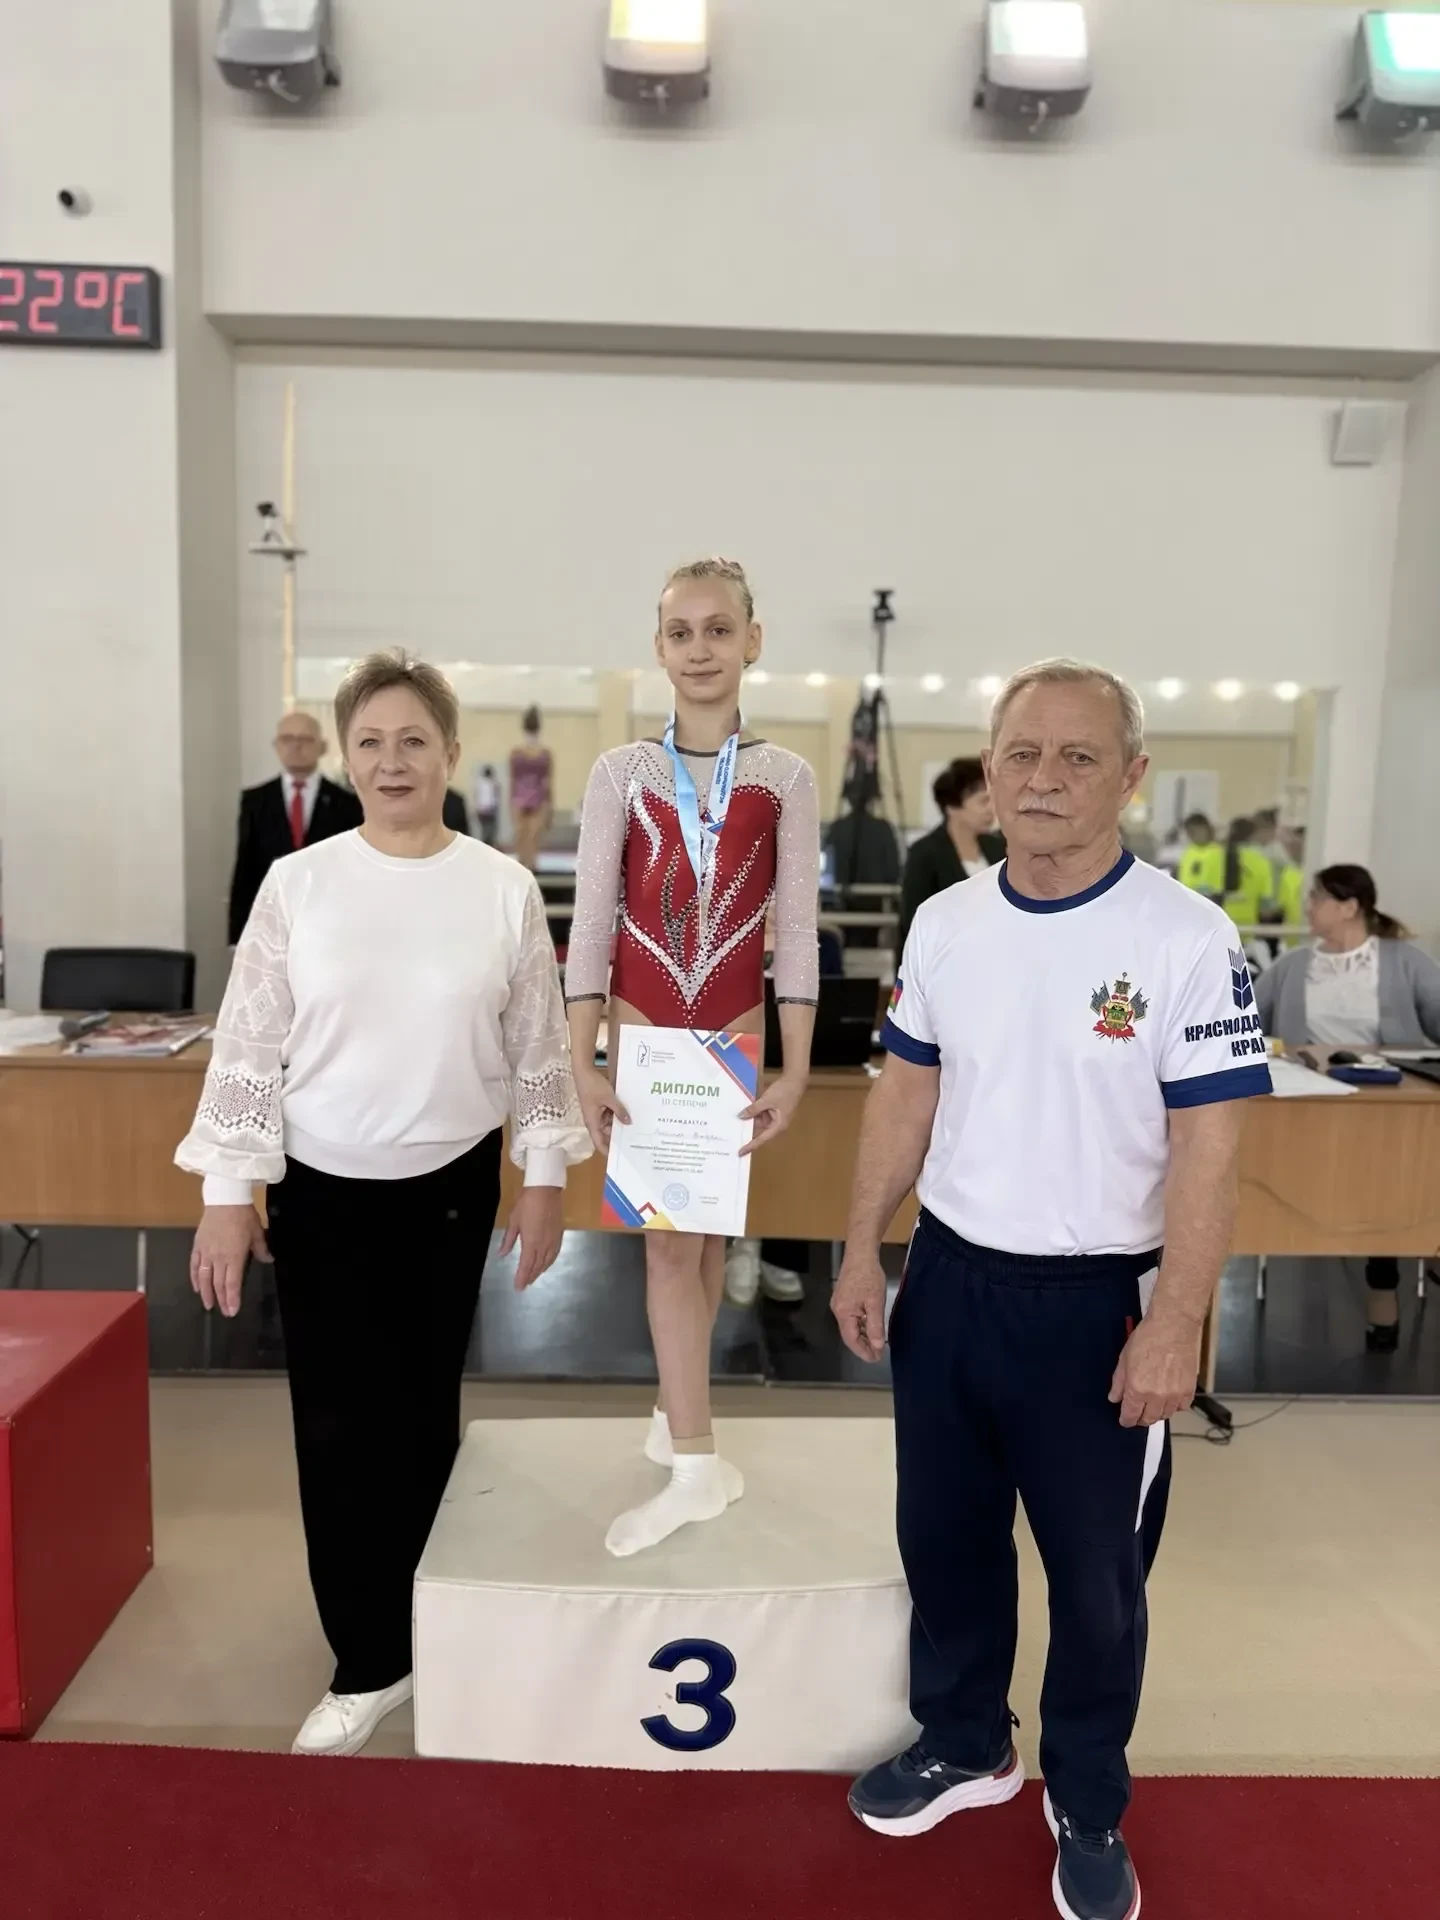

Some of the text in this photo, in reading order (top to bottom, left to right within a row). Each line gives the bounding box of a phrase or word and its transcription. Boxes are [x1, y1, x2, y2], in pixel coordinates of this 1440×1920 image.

[650, 1081, 720, 1098] ДИПЛОМ
[657, 1117, 708, 1126] НАГРАЖДАЕТСЯ
[640, 1638, 736, 1751] 3
